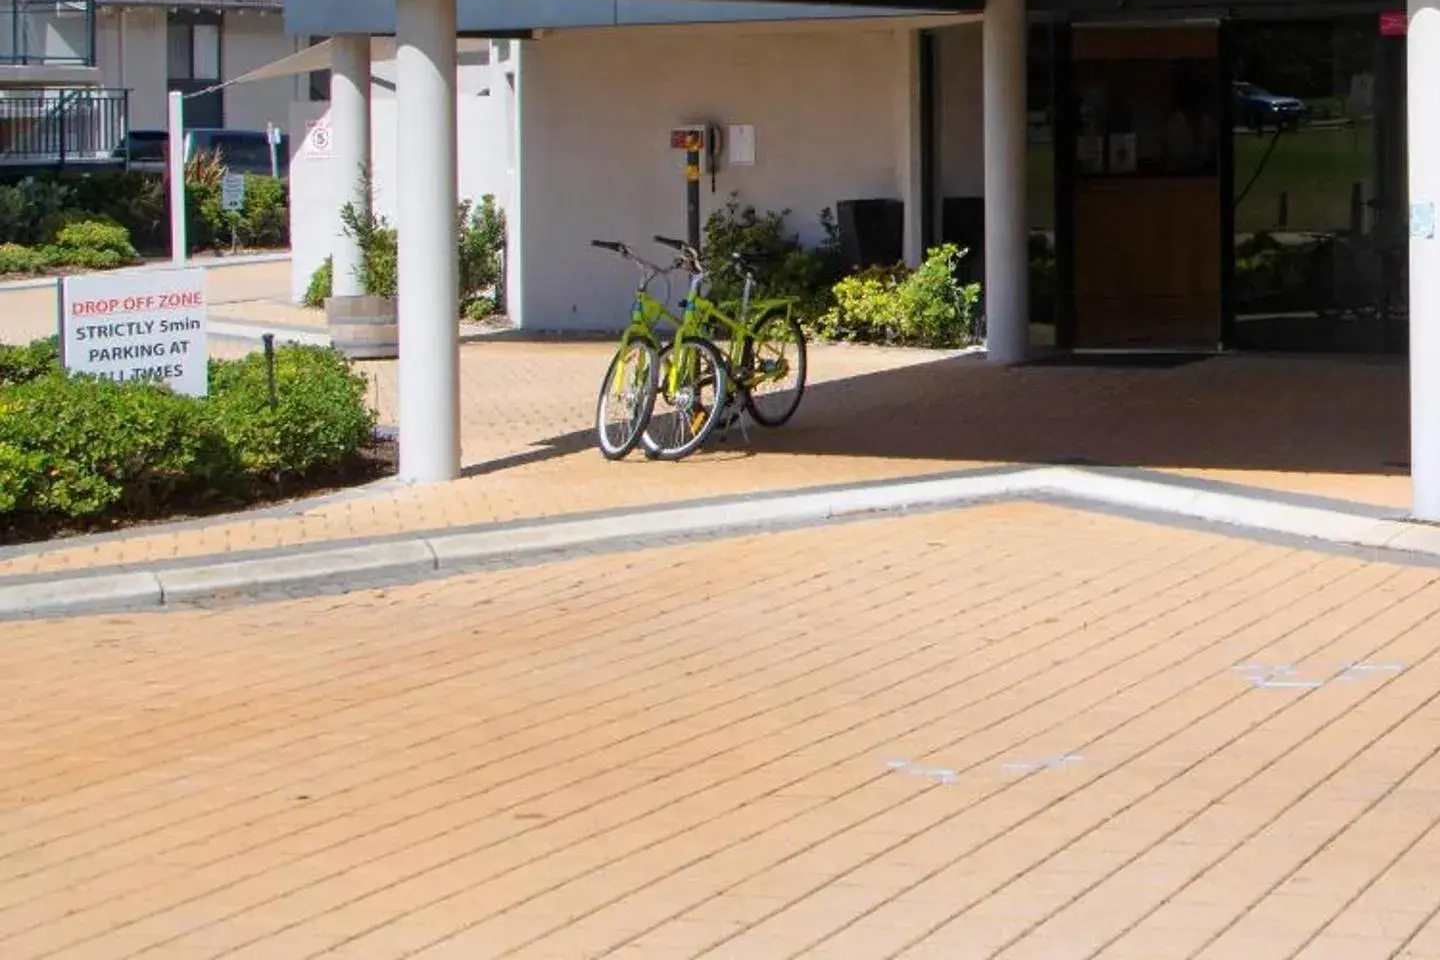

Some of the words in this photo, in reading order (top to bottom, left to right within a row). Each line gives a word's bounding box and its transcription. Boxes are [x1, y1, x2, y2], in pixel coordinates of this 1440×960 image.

[72, 298, 118, 316] DROP
[123, 295, 156, 311] OFF
[159, 291, 202, 308] ZONE
[76, 320, 154, 341] STRICTLY
[160, 316, 200, 333] 5min
[89, 342, 165, 362] PARKING
[170, 340, 190, 354] AT
[131, 363, 183, 381] TIMES
